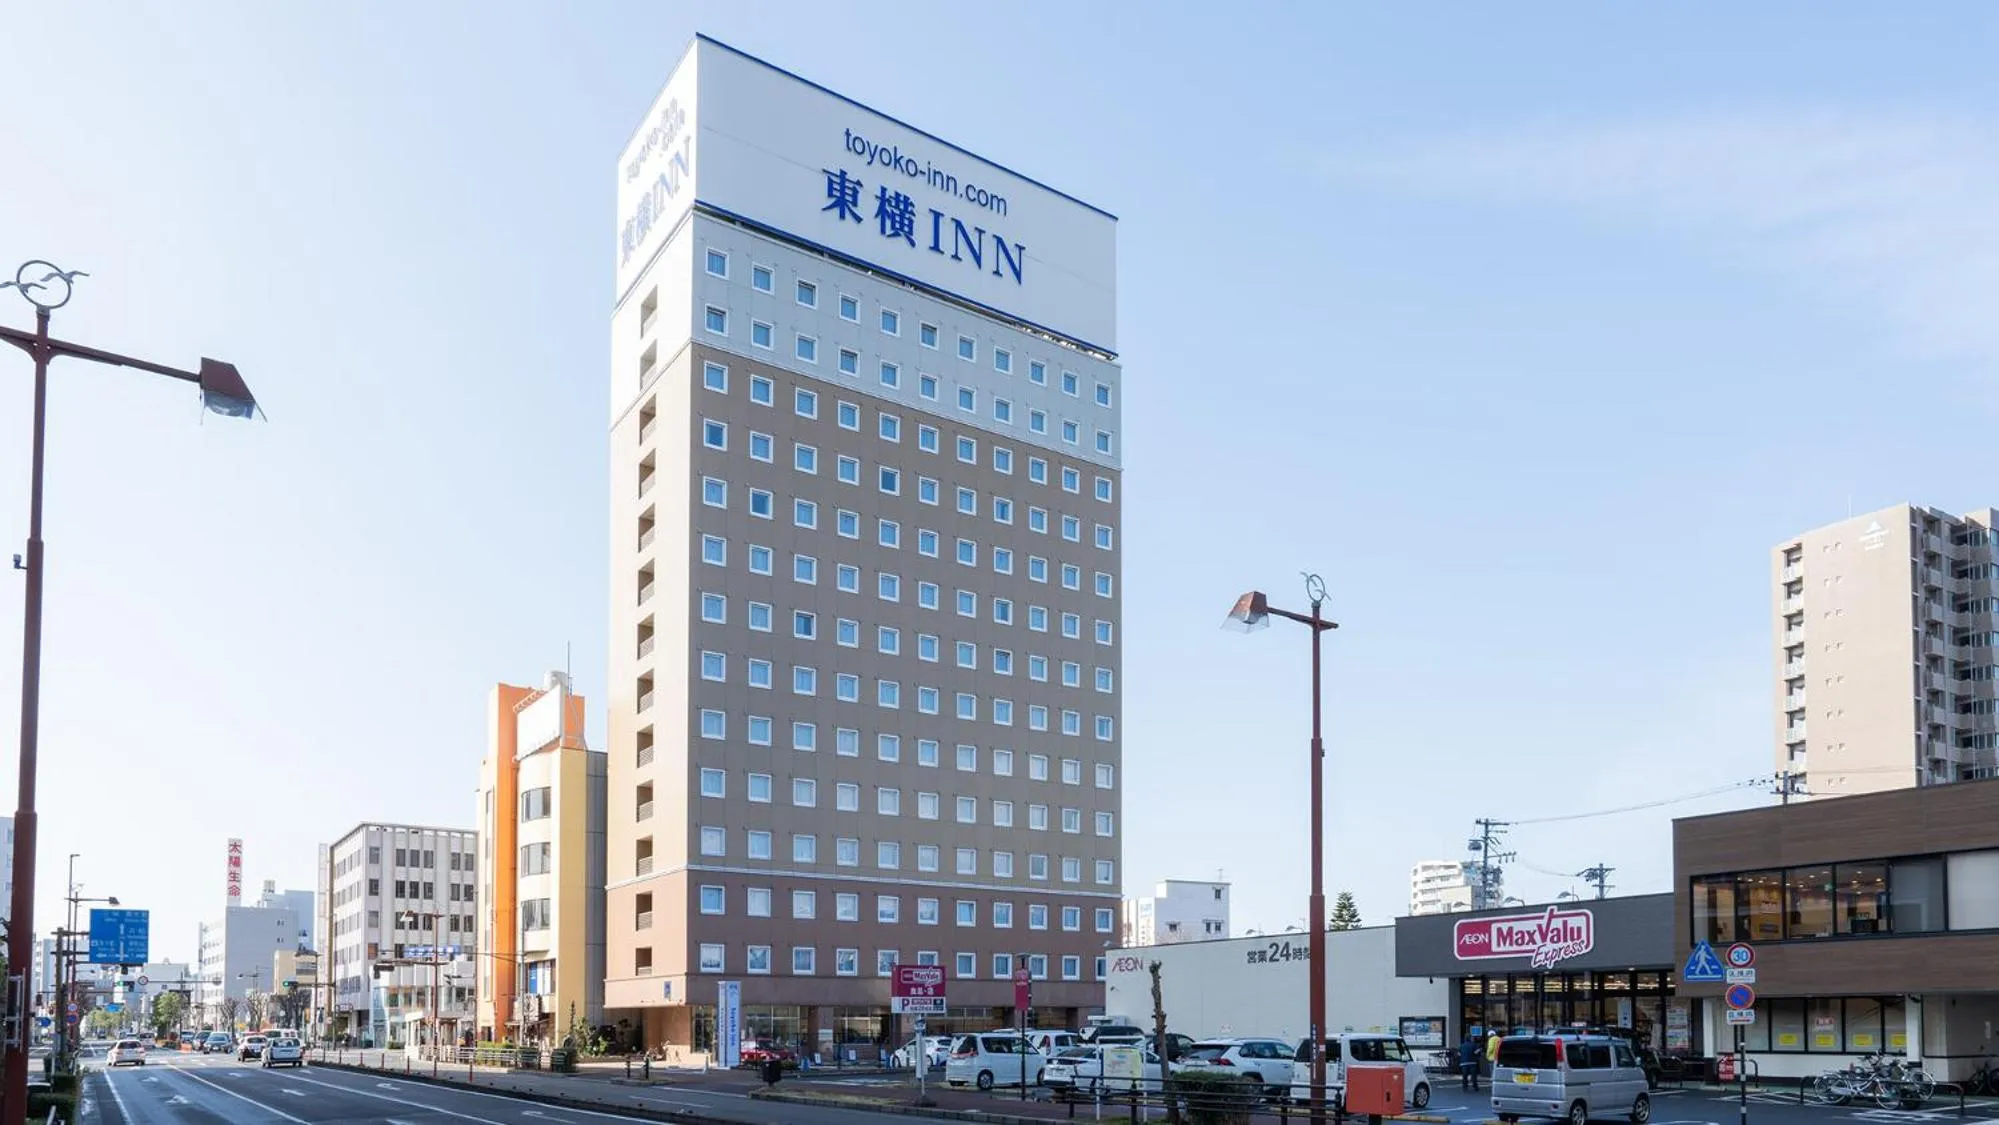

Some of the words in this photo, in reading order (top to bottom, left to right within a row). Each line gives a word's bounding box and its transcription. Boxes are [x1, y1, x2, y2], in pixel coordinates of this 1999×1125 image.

[844, 128, 1007, 216] toyoko-inn.com
[228, 841, 242, 897] 太陽生命
[1496, 908, 1583, 948] MaxValu
[1532, 939, 1586, 968] Express
[1733, 950, 1749, 963] 30
[901, 998, 910, 1011] P
